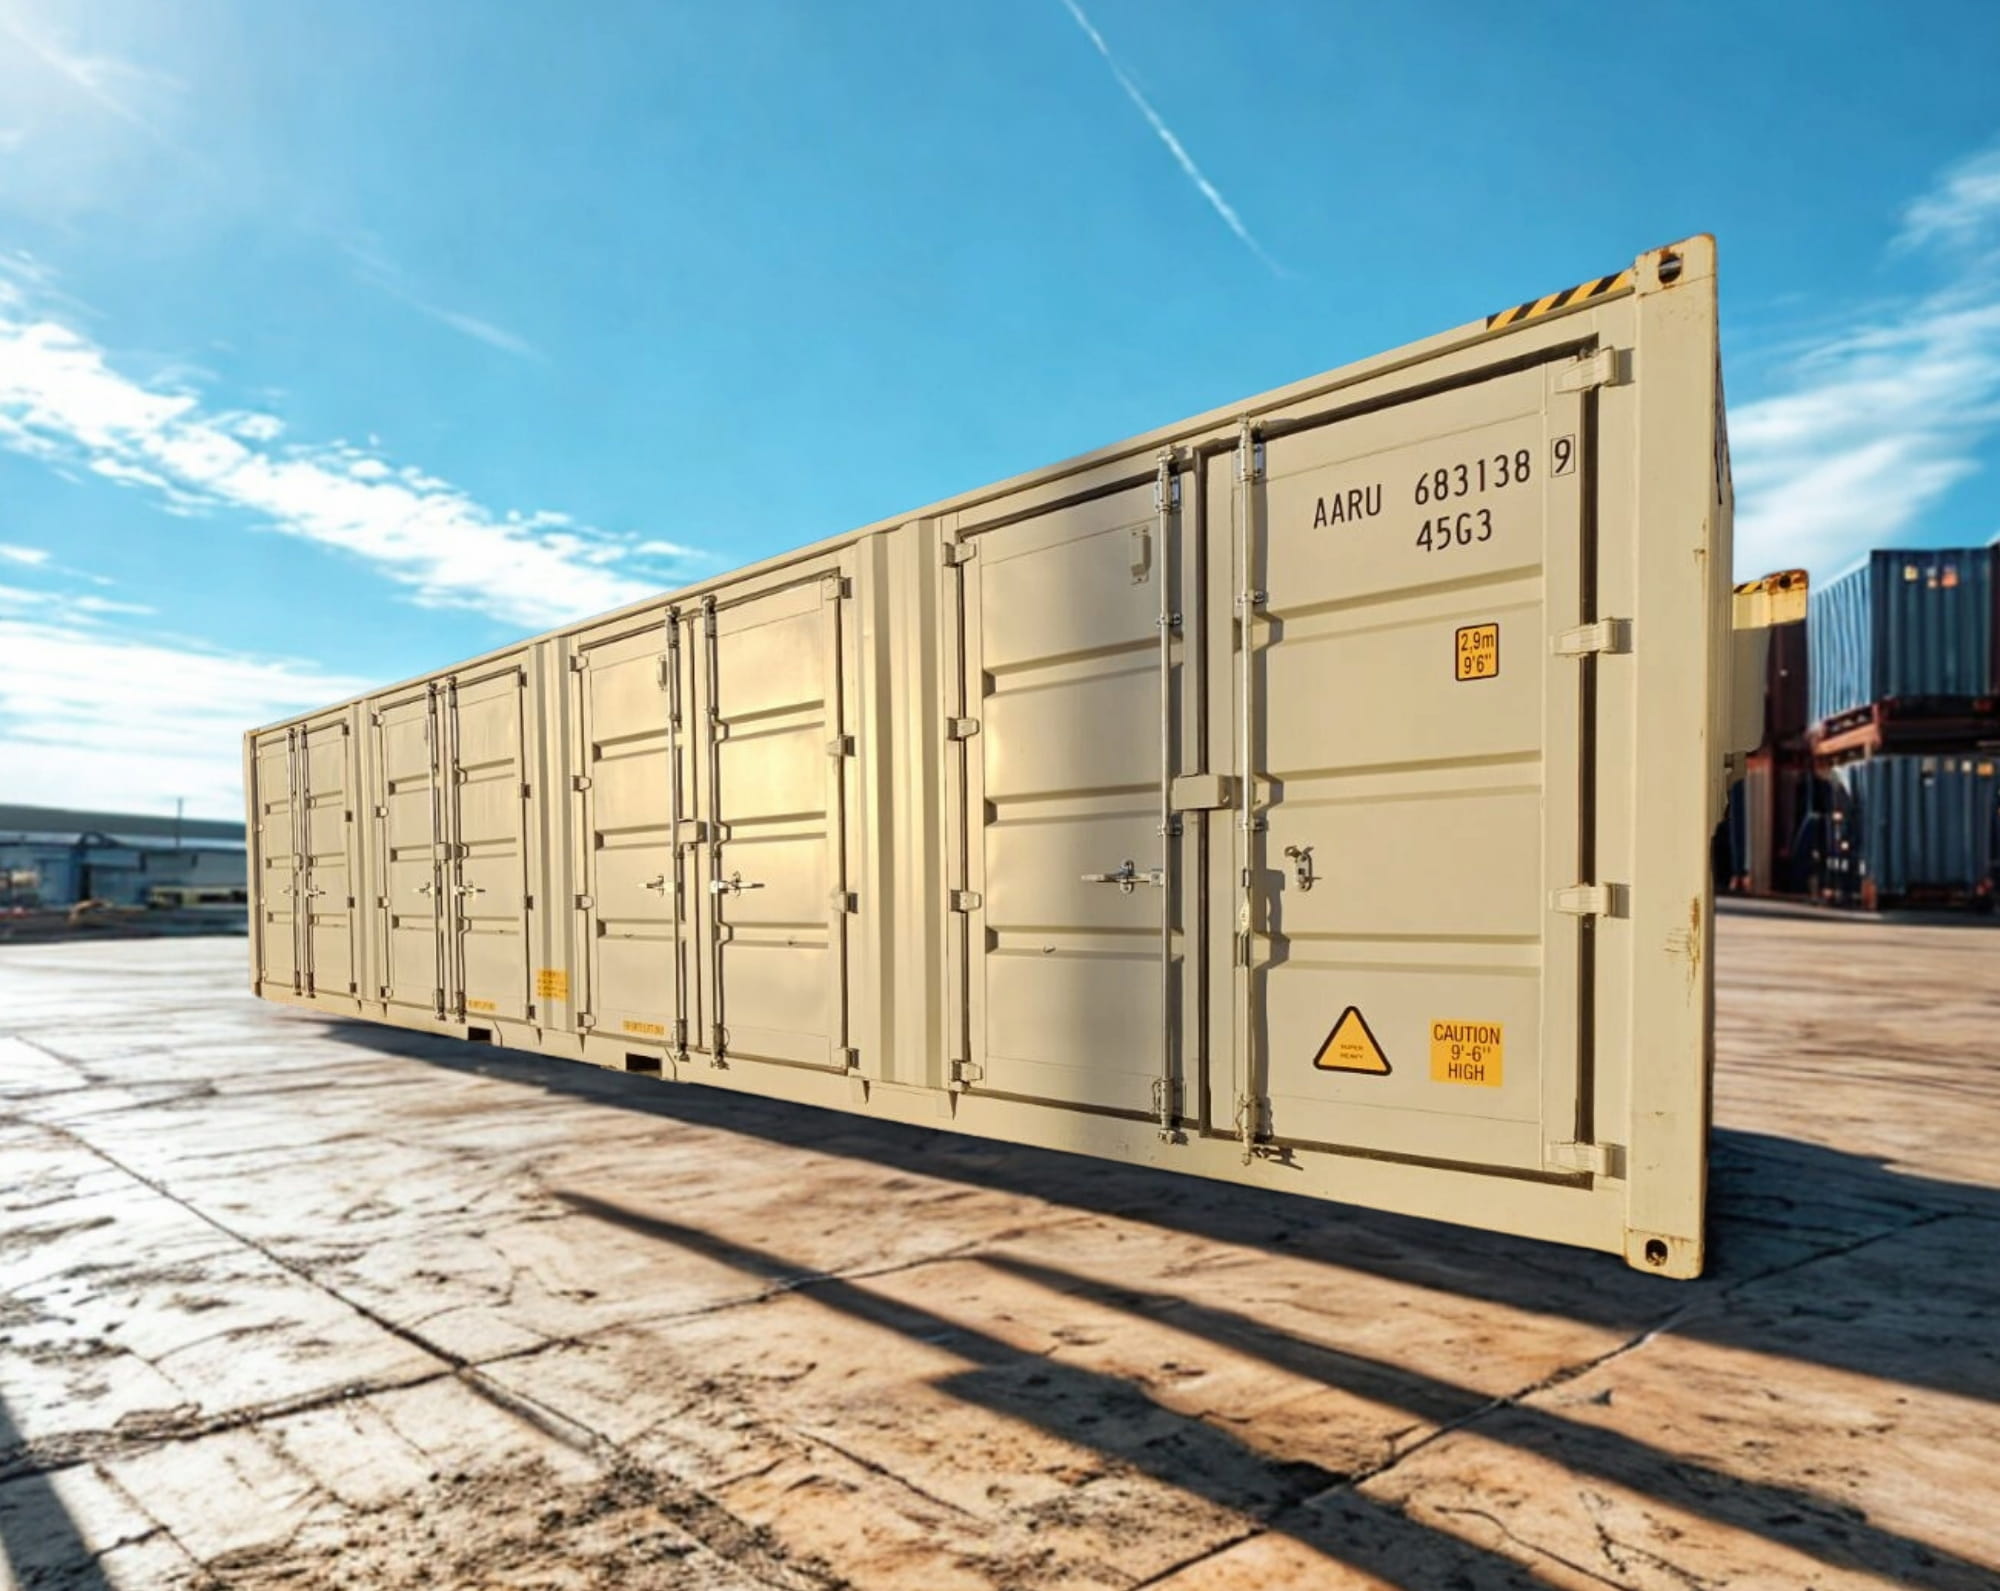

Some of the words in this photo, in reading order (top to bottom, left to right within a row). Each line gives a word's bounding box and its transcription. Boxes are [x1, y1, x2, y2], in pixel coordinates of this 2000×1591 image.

[1313, 484, 1382, 529] AARU
[1414, 449, 1531, 505] 683138
[1554, 438, 1572, 475] 9
[1416, 508, 1493, 553] 45G3
[1433, 1023, 1501, 1046] CAUTION
[1448, 1062, 1485, 1082] HIGH
